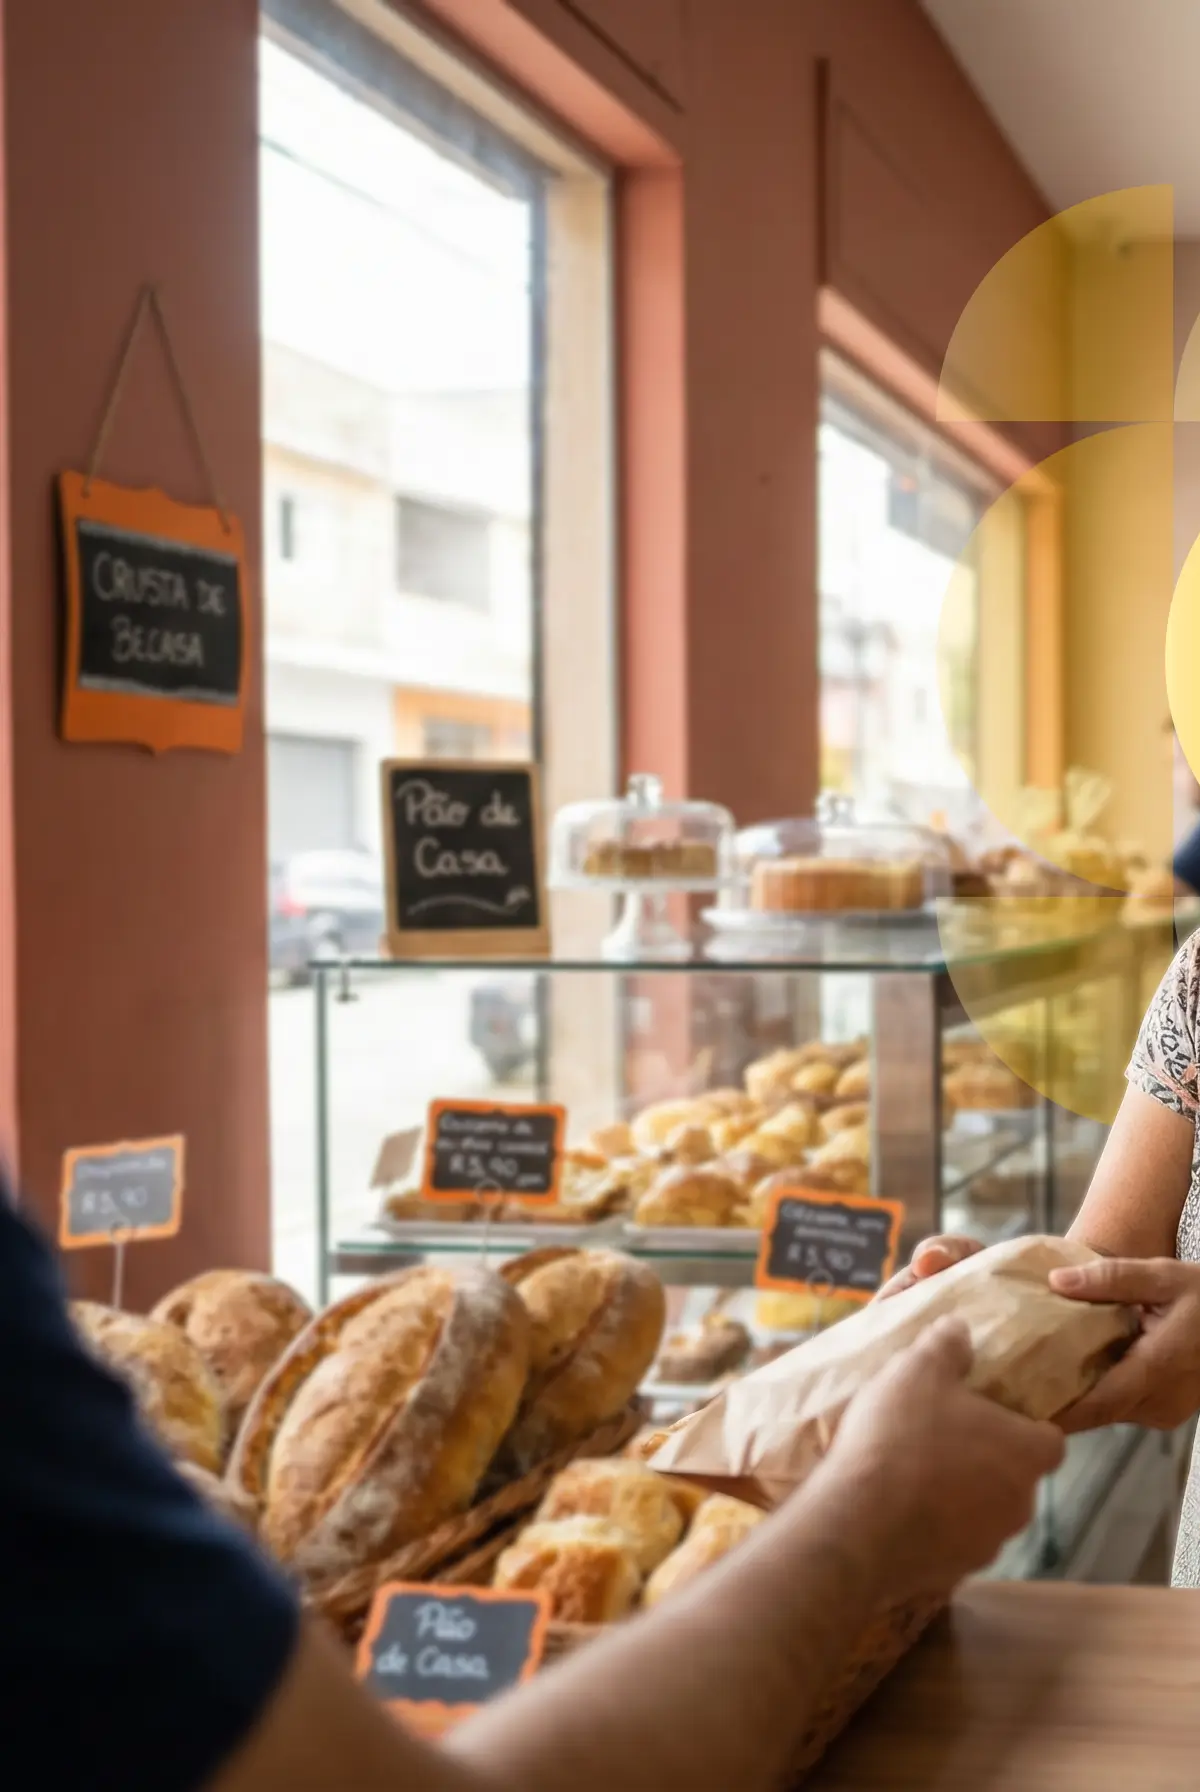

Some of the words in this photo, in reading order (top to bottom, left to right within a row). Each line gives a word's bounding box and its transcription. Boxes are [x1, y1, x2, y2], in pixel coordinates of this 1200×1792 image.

[396, 778, 472, 827] Pão
[479, 787, 522, 827] de
[413, 835, 510, 879] Casa
[412, 1600, 478, 1641] Pão
[374, 1642, 409, 1675] de
[414, 1645, 490, 1681] Casa
